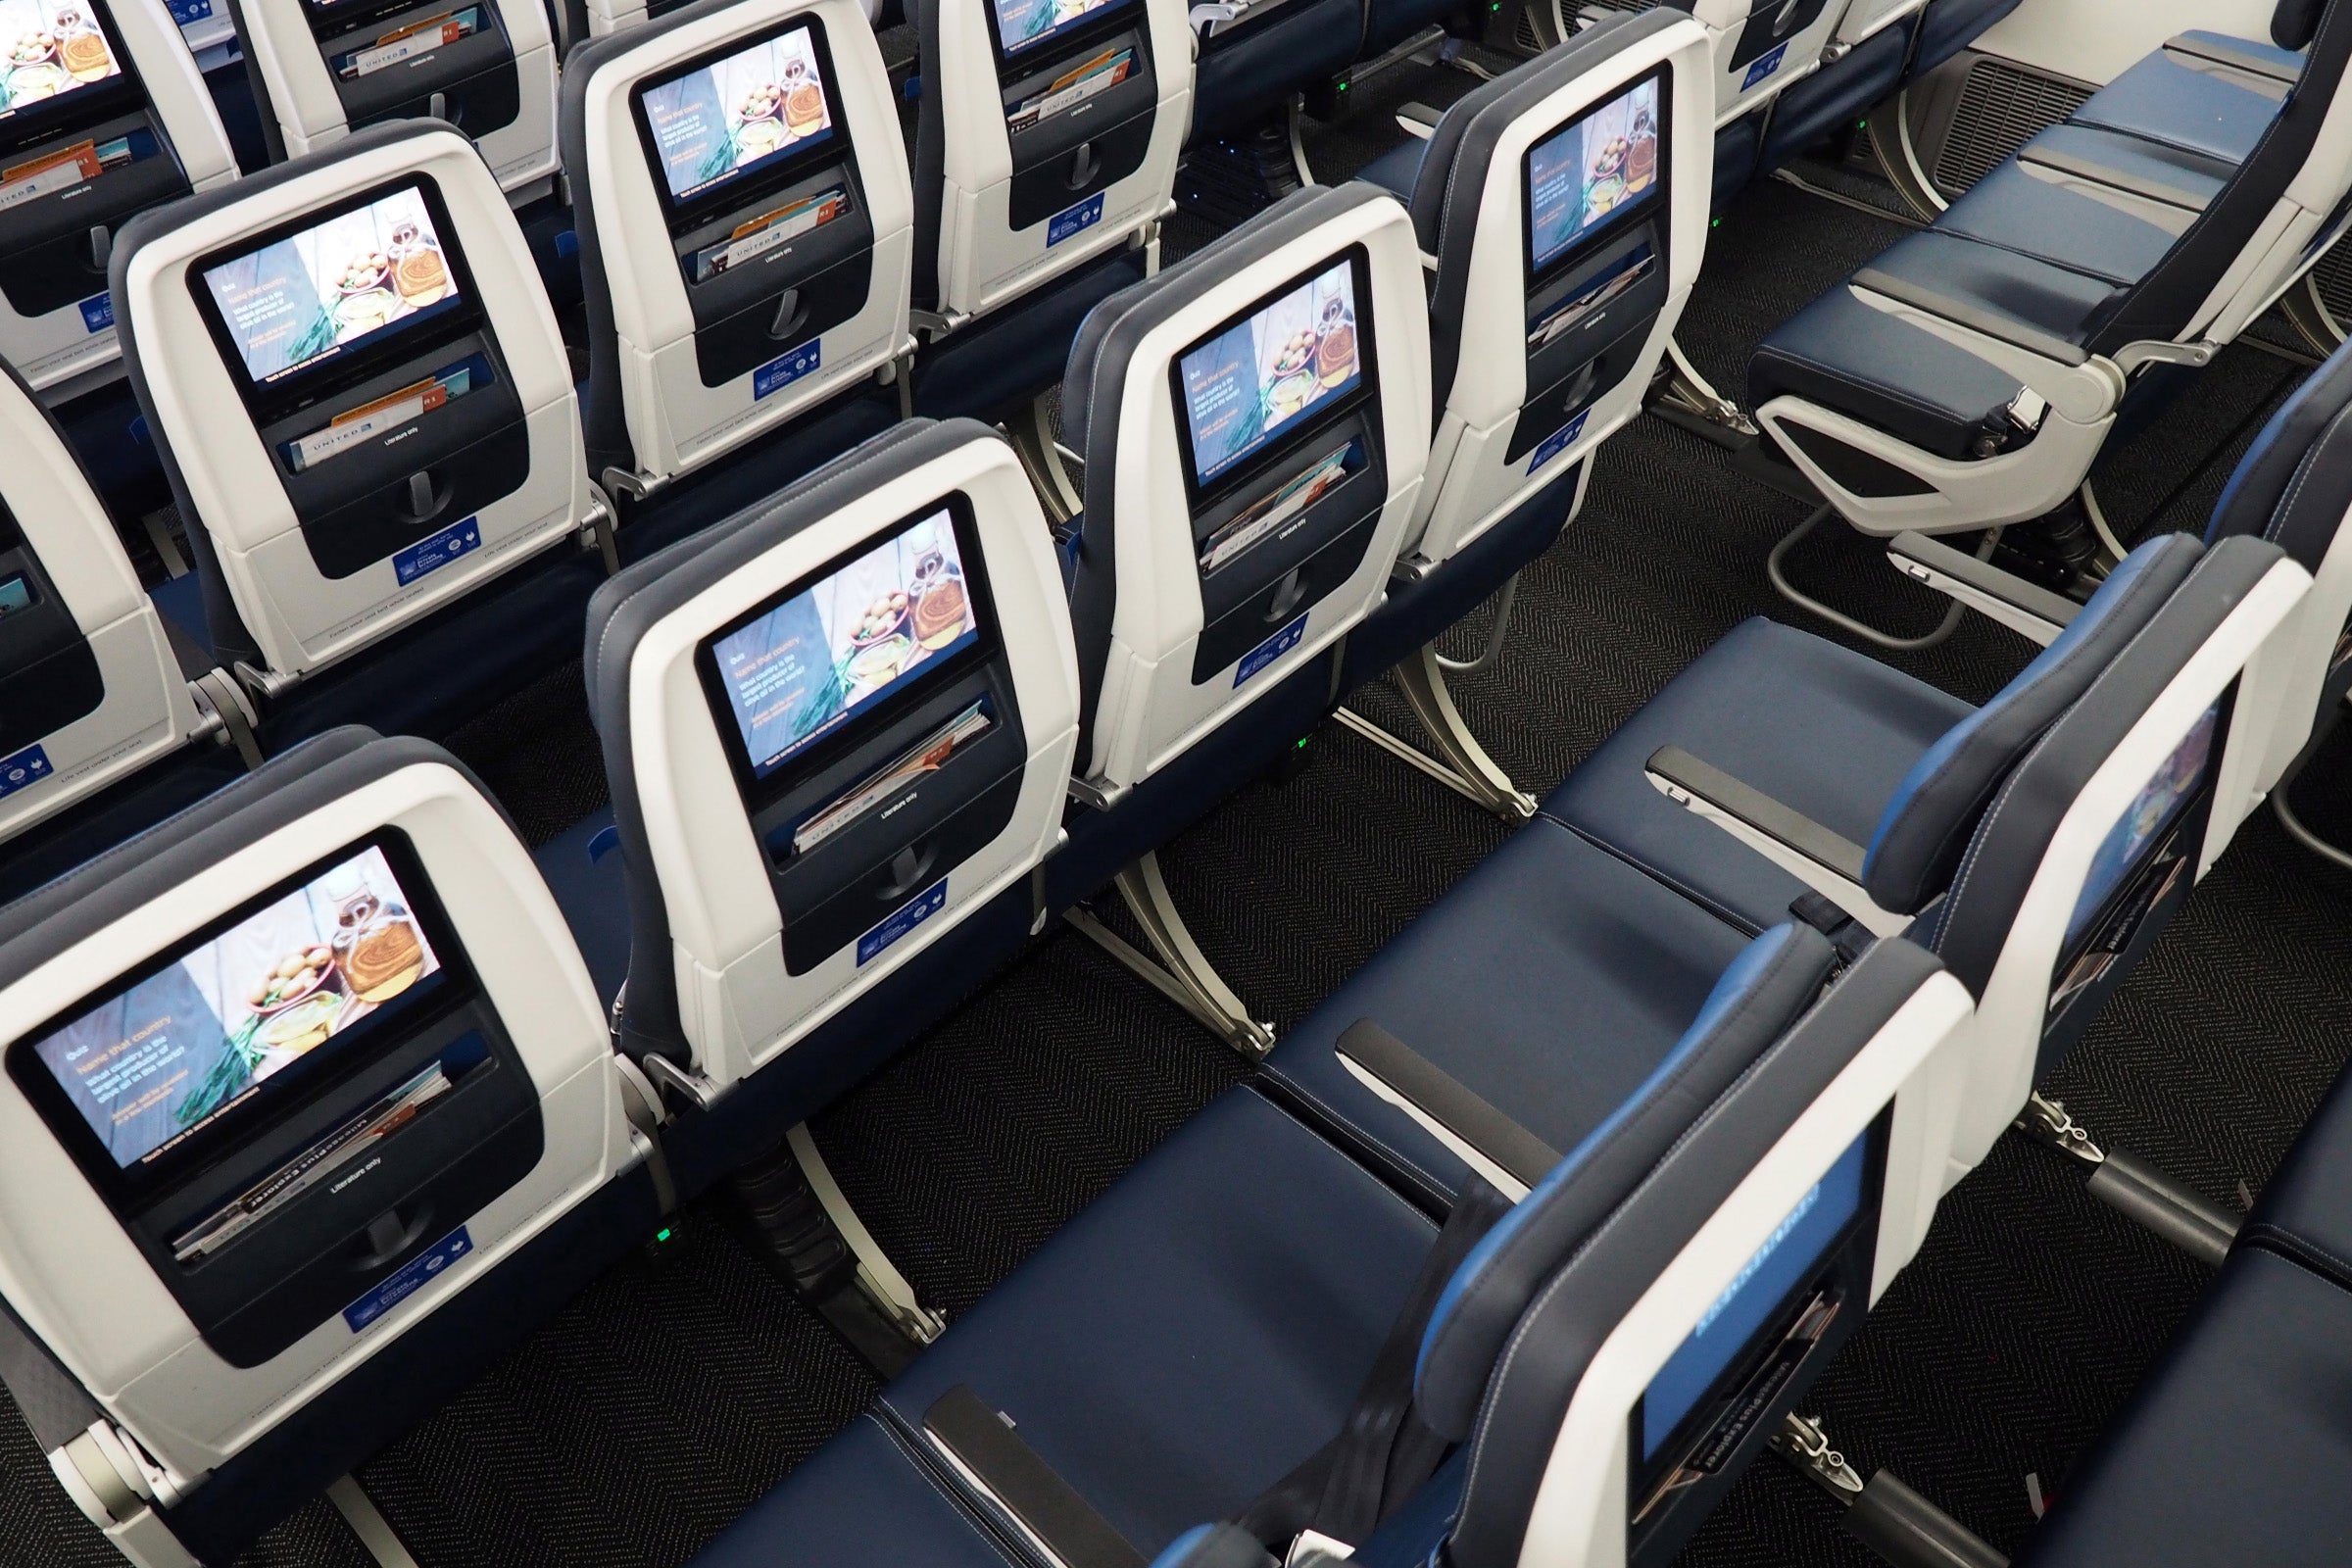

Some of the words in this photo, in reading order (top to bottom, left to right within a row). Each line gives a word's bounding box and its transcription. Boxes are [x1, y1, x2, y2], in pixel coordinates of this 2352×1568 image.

[366, 52, 398, 68] UNITED
[737, 238, 770, 257] UNITED
[313, 428, 359, 452] UNITED
[384, 431, 407, 446] Literature
[407, 426, 418, 437] only
[1221, 529, 1258, 557] UNITED
[1279, 523, 1298, 540] Literature
[881, 799, 906, 820] Literature
[906, 792, 917, 806] only
[141, 1148, 163, 1163] Touch
[162, 1134, 185, 1151] screen
[193, 1115, 214, 1131] access
[214, 1086, 260, 1117] entertainment
[300, 1117, 368, 1169] MileagePlus
[250, 1168, 301, 1208] Explorer
[329, 1164, 366, 1195] Literature
[364, 1155, 381, 1175] only
[1705, 1422, 1744, 1469] Explorer
